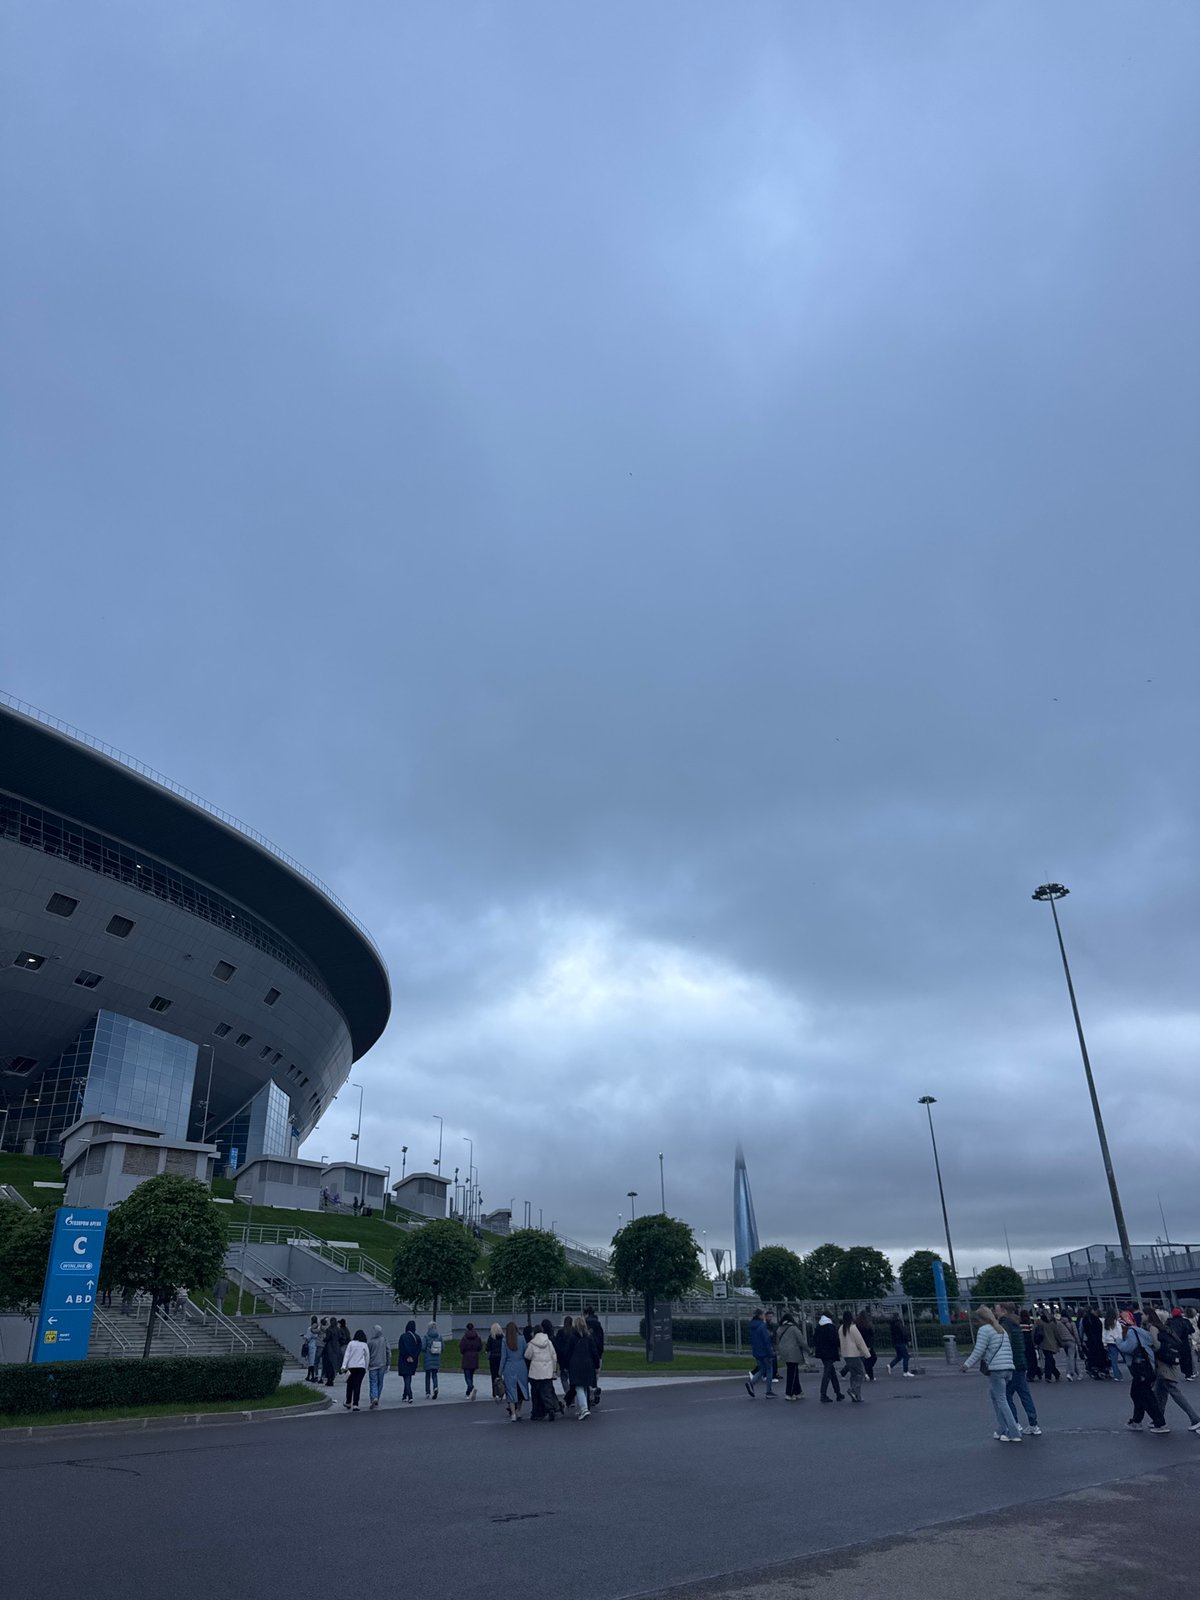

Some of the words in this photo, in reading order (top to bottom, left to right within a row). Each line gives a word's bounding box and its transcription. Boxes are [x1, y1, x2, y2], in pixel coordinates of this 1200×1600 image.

[73, 1236, 88, 1255] C
[65, 1295, 73, 1303] A
[75, 1295, 83, 1303] B
[84, 1295, 92, 1303] D
